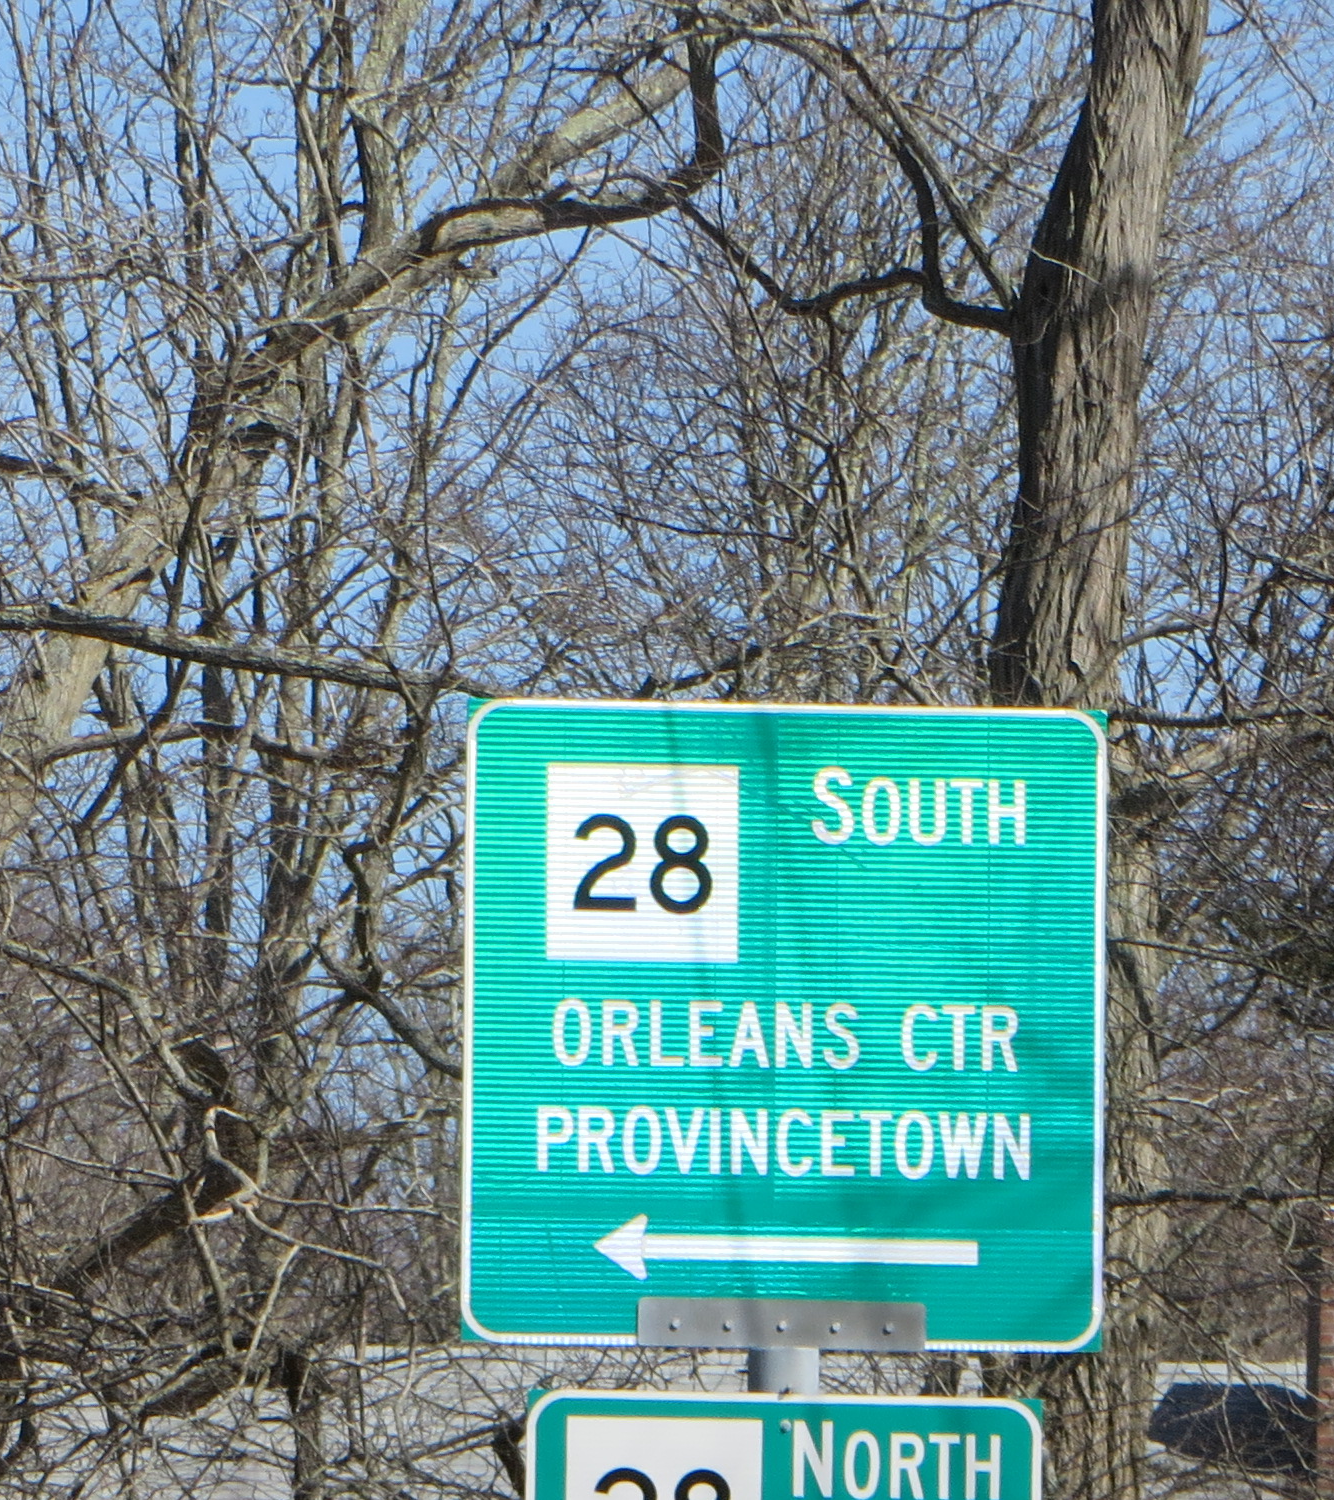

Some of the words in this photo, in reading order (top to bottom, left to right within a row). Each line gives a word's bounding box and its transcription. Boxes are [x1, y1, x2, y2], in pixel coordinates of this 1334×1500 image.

[810, 766, 1028, 847] SOUTH
[573, 813, 713, 915] 28
[552, 998, 861, 1071] ORLEANS
[901, 1004, 1020, 1073] CTR
[535, 1105, 1032, 1181] PROVINCETOWN
